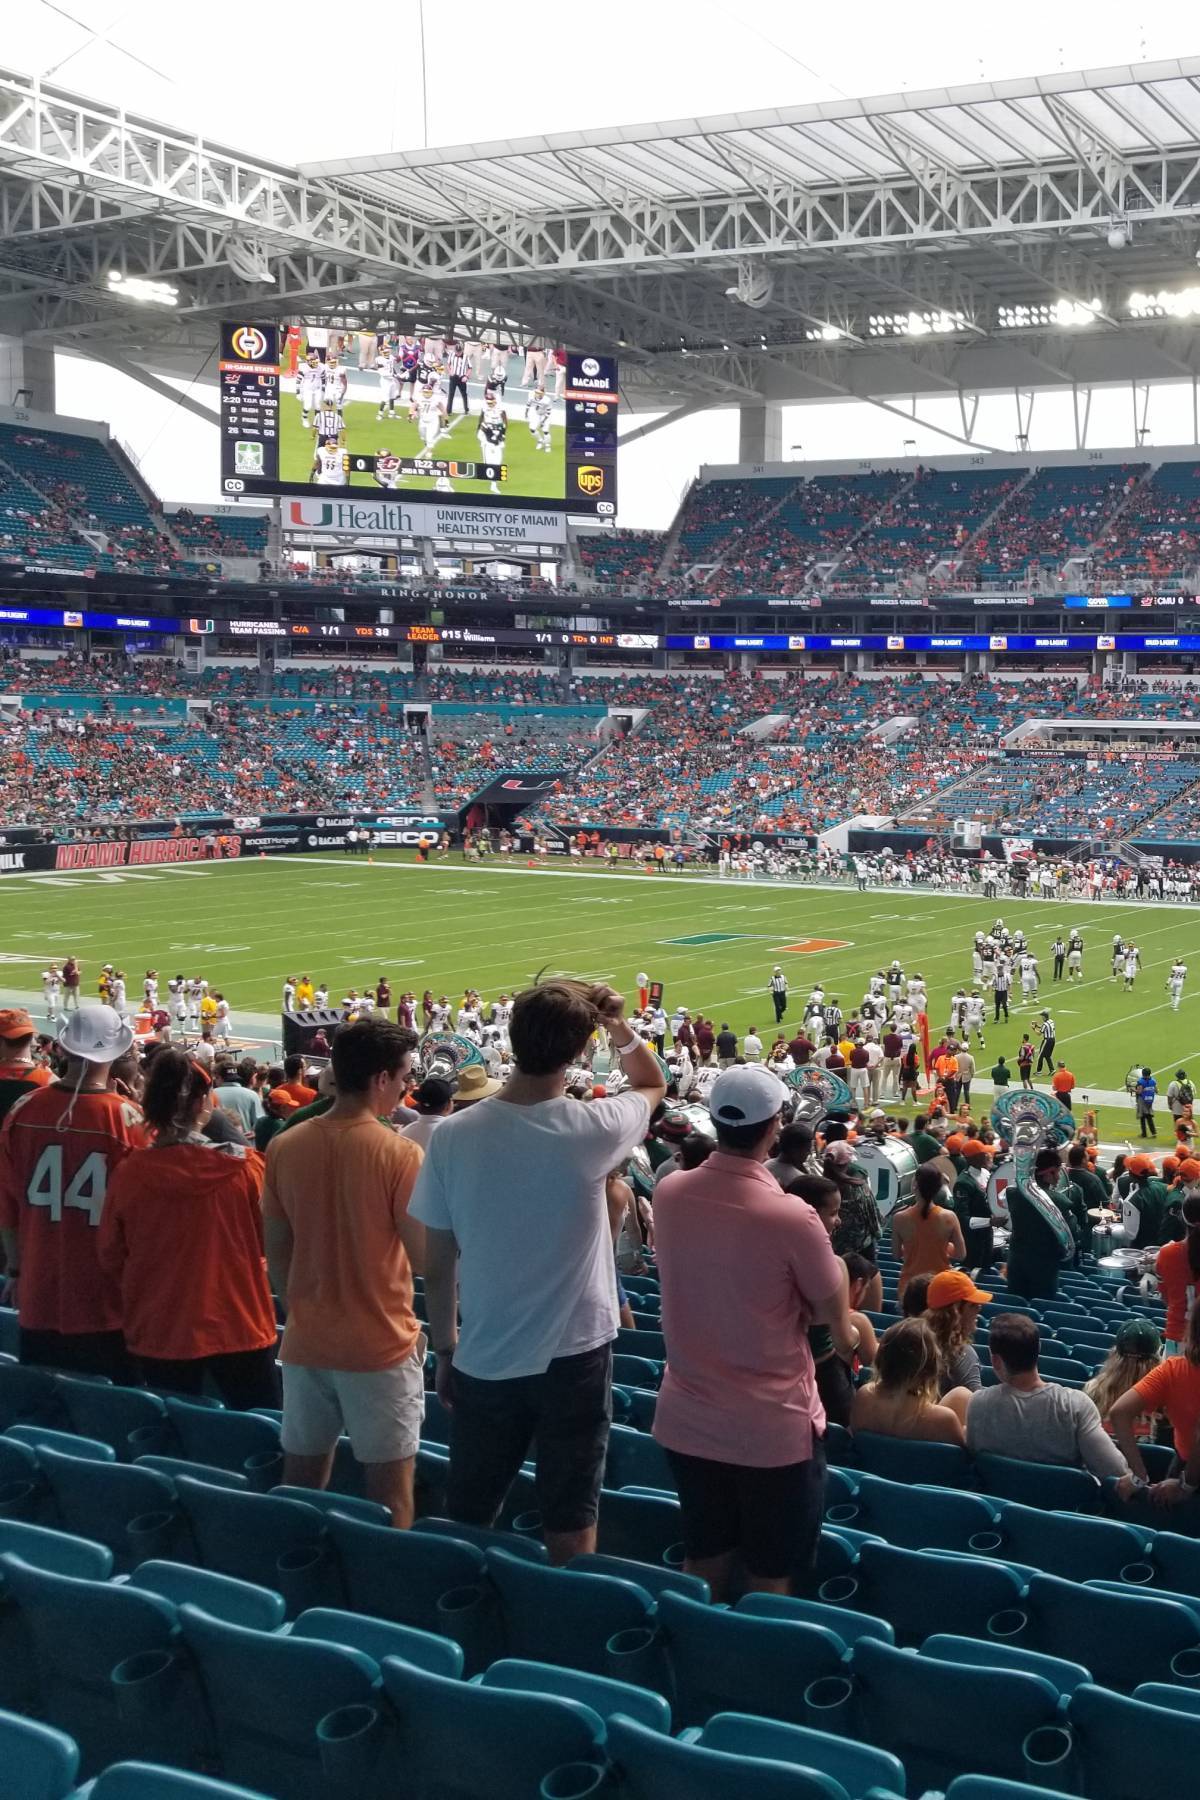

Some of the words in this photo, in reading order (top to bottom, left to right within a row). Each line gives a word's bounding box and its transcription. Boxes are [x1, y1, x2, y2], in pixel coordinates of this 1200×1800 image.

[223, 396, 241, 404] 2:20
[259, 399, 278, 407] 0:00
[229, 416, 238, 424] 17
[263, 429, 275, 437] 50
[970, 457, 984, 465] 343
[356, 460, 365, 471] 0
[414, 460, 434, 469] 11:22
[486, 468, 495, 478] 0
[226, 480, 243, 491] CC
[580, 474, 602, 490] ups
[215, 505, 232, 514] 337
[599, 504, 613, 513] CC
[437, 510, 502, 523] UNIVERSITY
[504, 514, 519, 524] OF
[526, 514, 558, 526] MIAMI
[437, 523, 479, 535] HEALTH
[482, 525, 526, 537] SYSTEM
[381, 589, 420, 598] RING
[434, 591, 488, 600] HONOR
[1157, 596, 1176, 605] CMU
[1178, 597, 1184, 605] 0
[190, 618, 214, 634] U
[229, 621, 279, 629] HURRICANES
[292, 626, 309, 634] C/A
[355, 627, 373, 636] YDS
[375, 628, 390, 637] 38
[407, 633, 440, 641] LEADER
[442, 630, 461, 639] #15
[463, 634, 496, 643] Williams
[535, 634, 552, 643] 1/1
[562, 635, 569, 643] 0
[572, 635, 588, 644] TDs
[590, 636, 597, 644] 0
[600, 636, 614, 645] INT
[1147, 753, 1179, 761] SOCIETY
[245, 838, 272, 846] ROCKET
[272, 836, 300, 845] Mortgage
[368, 831, 439, 844] GEICO
[55, 842, 128, 870] MIAMI
[27, 1144, 108, 1227] 44
